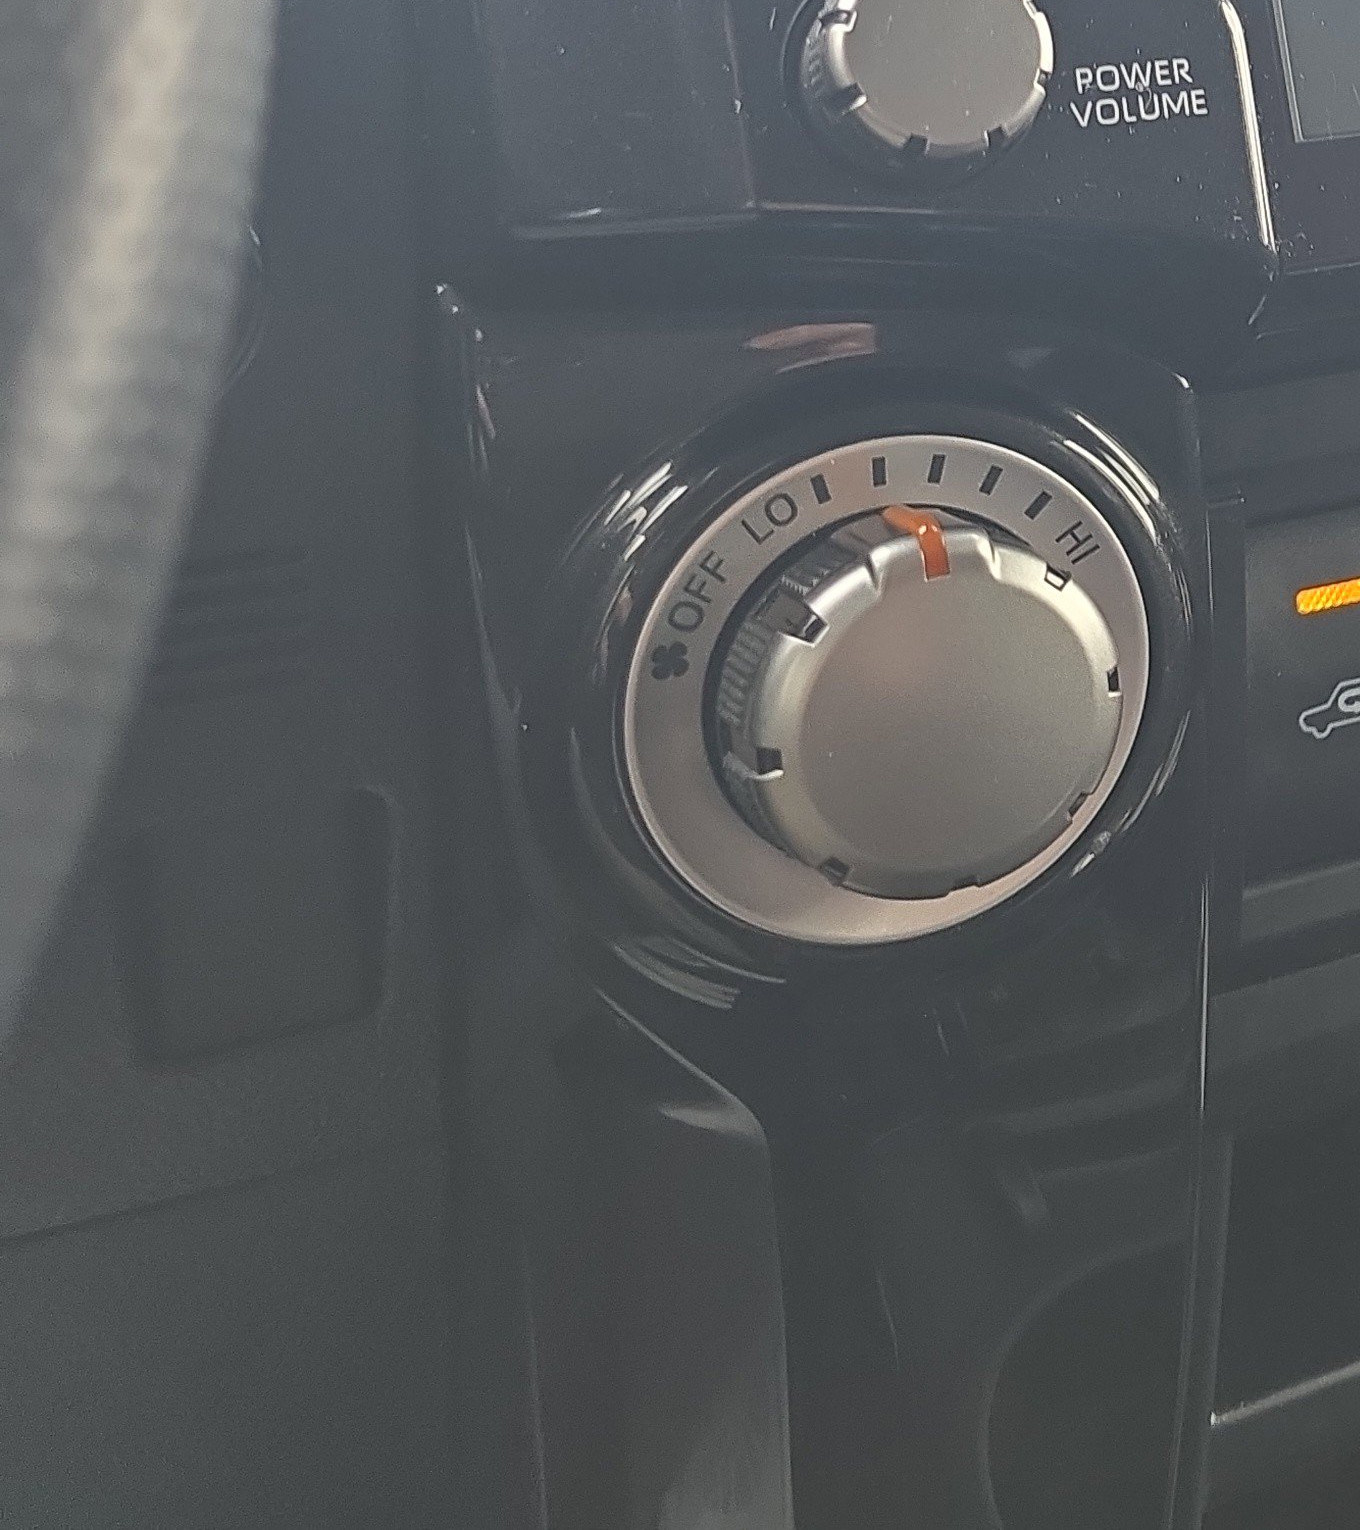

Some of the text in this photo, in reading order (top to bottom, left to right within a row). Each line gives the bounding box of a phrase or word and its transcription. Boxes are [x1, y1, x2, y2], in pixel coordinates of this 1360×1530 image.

[1075, 57, 1193, 94] POWER
[1070, 89, 1209, 128] VOLUME
[741, 493, 799, 547] LO
[1056, 521, 1102, 566] HI
[668, 550, 730, 632] OFF
